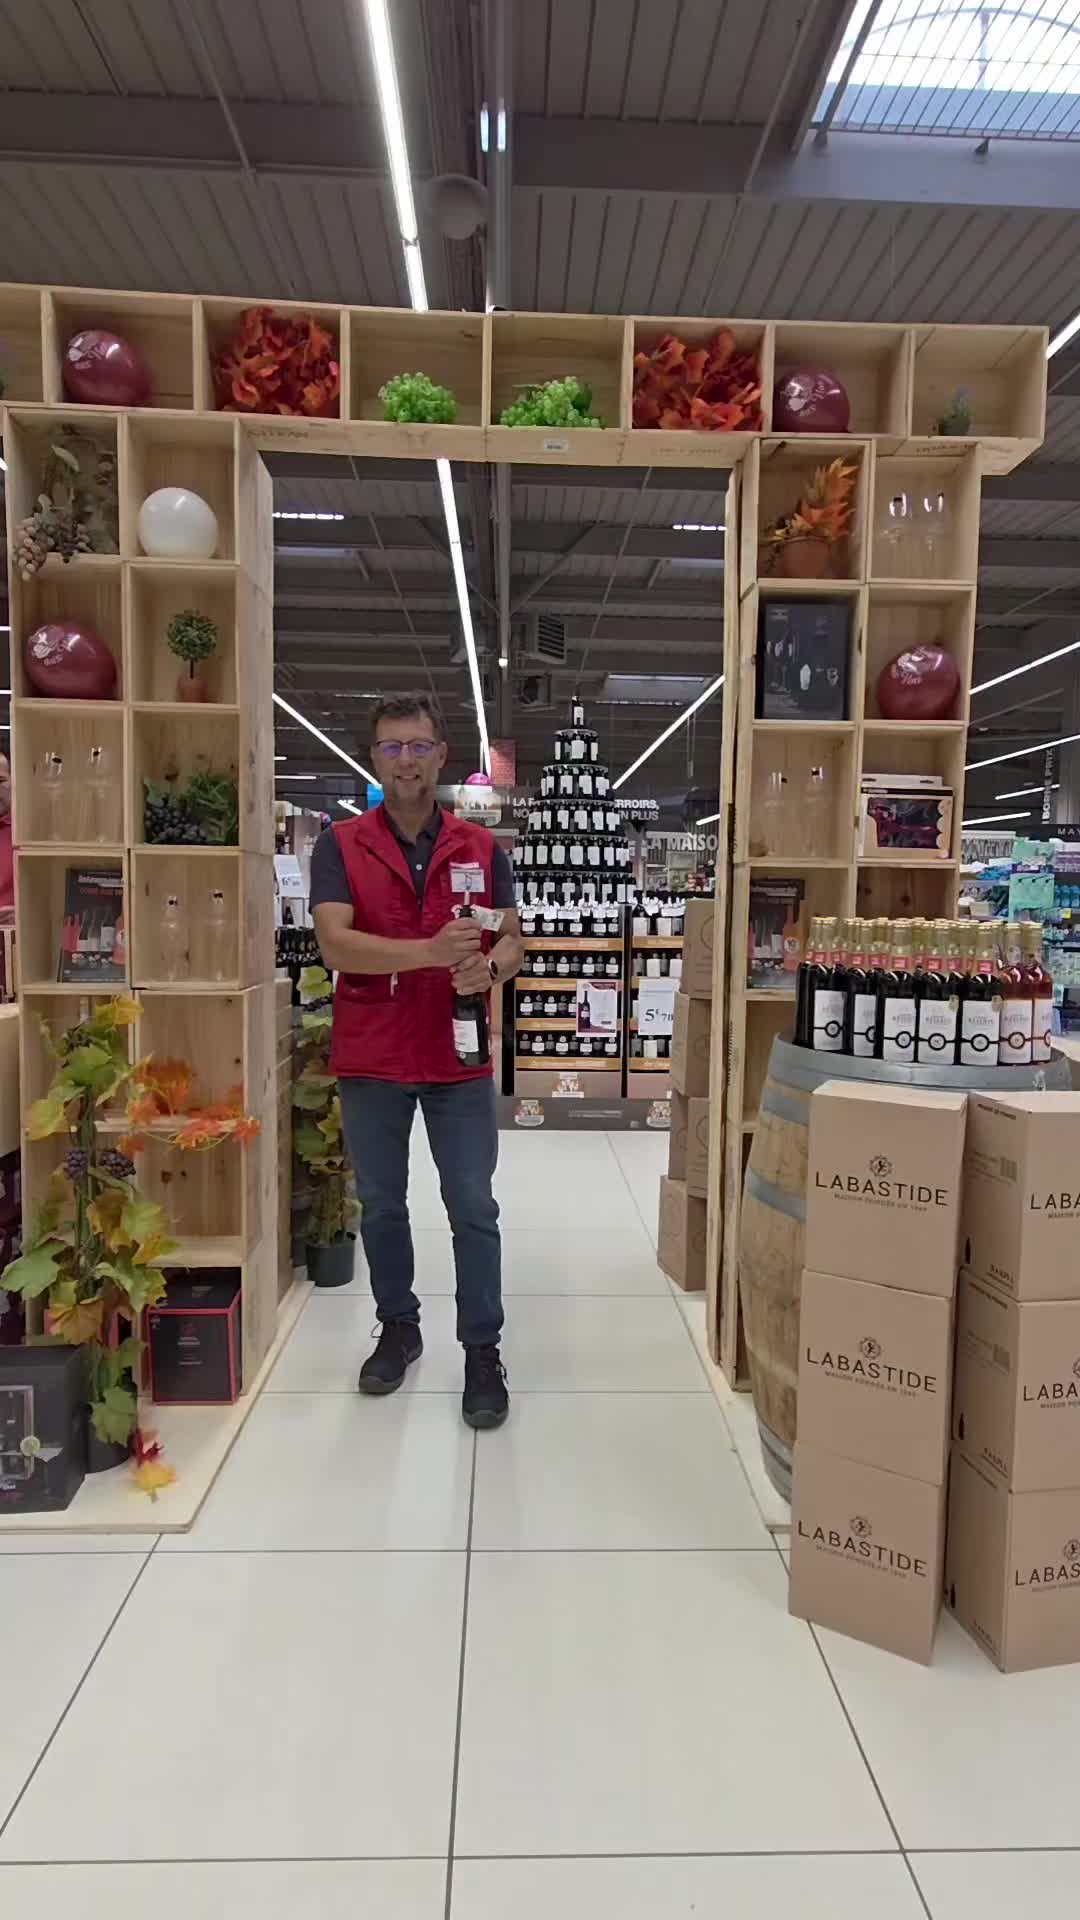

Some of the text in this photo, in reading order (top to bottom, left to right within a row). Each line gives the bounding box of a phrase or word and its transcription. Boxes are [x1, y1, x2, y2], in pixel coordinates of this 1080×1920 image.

[513, 808, 658, 820] NO N PLUS
[666, 832, 717, 851] MAISO
[815, 1171, 949, 1206] LABASTIDE
[1030, 1193, 1080, 1210] LABA
[807, 1347, 937, 1394] LABASTIDE
[1023, 1382, 1080, 1402] LABA
[798, 1519, 928, 1578] LABASTIDE
[1015, 1562, 1080, 1587] LABAS
